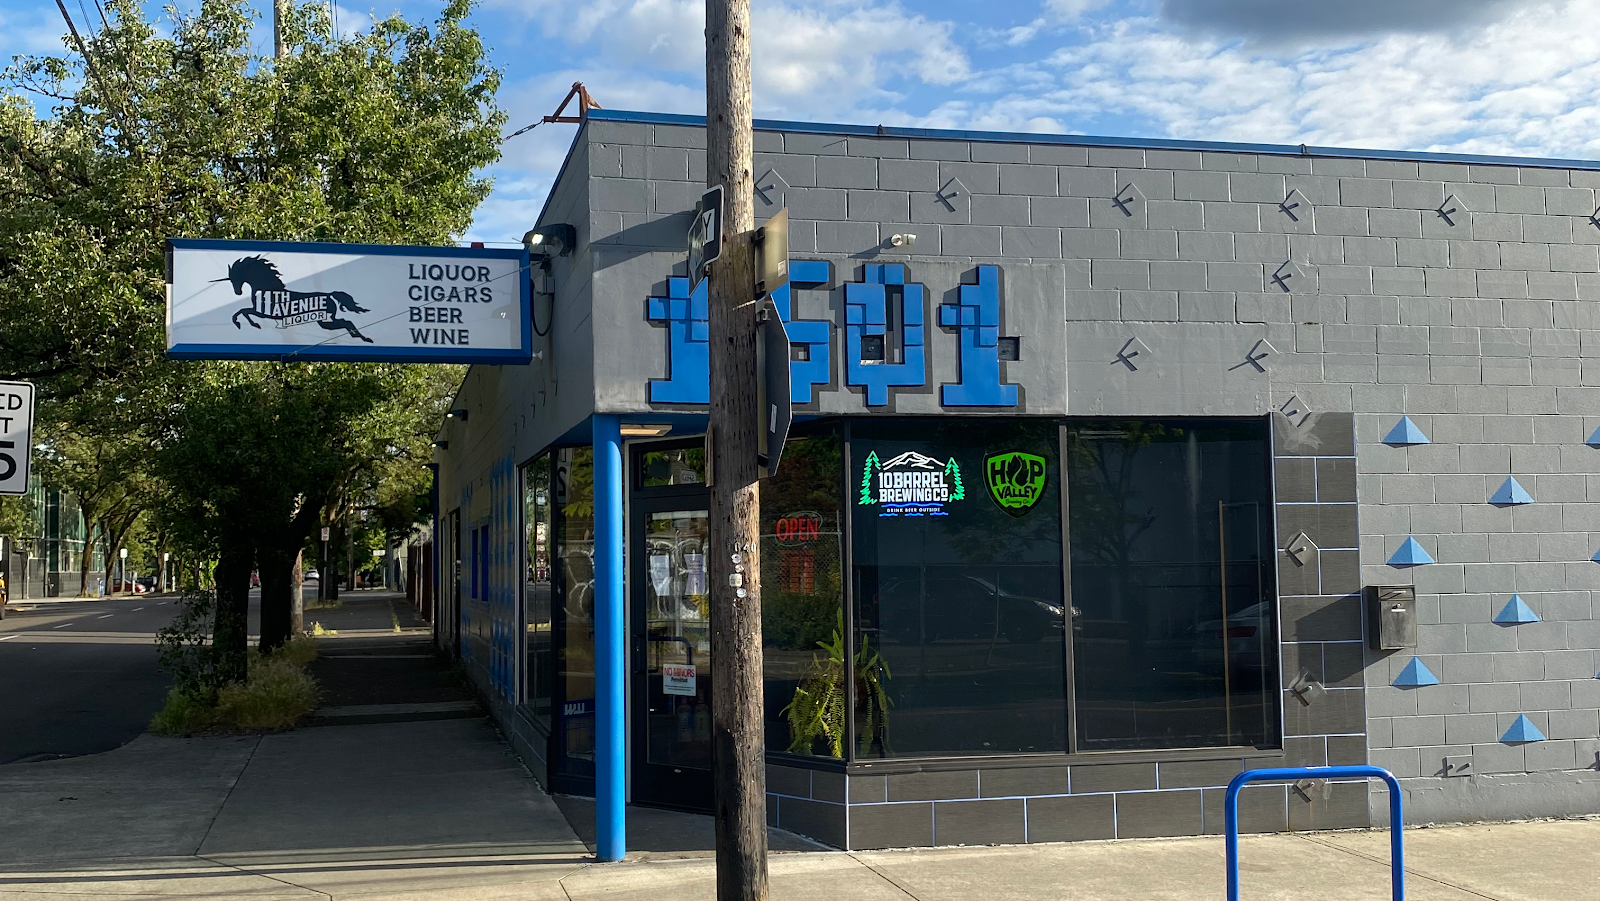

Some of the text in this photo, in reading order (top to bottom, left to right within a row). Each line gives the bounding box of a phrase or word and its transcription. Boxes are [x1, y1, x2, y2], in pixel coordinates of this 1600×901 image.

[408, 263, 492, 282] LIQUOR
[408, 285, 493, 303] CIGARS
[272, 296, 327, 317] AVENUE
[408, 306, 464, 324] BEER
[284, 311, 325, 326] LIQUOR
[409, 327, 470, 346] WINE
[996, 485, 1038, 500] VALLEY
[776, 518, 818, 541] OPEN
[664, 667, 695, 678] NO MINORS
